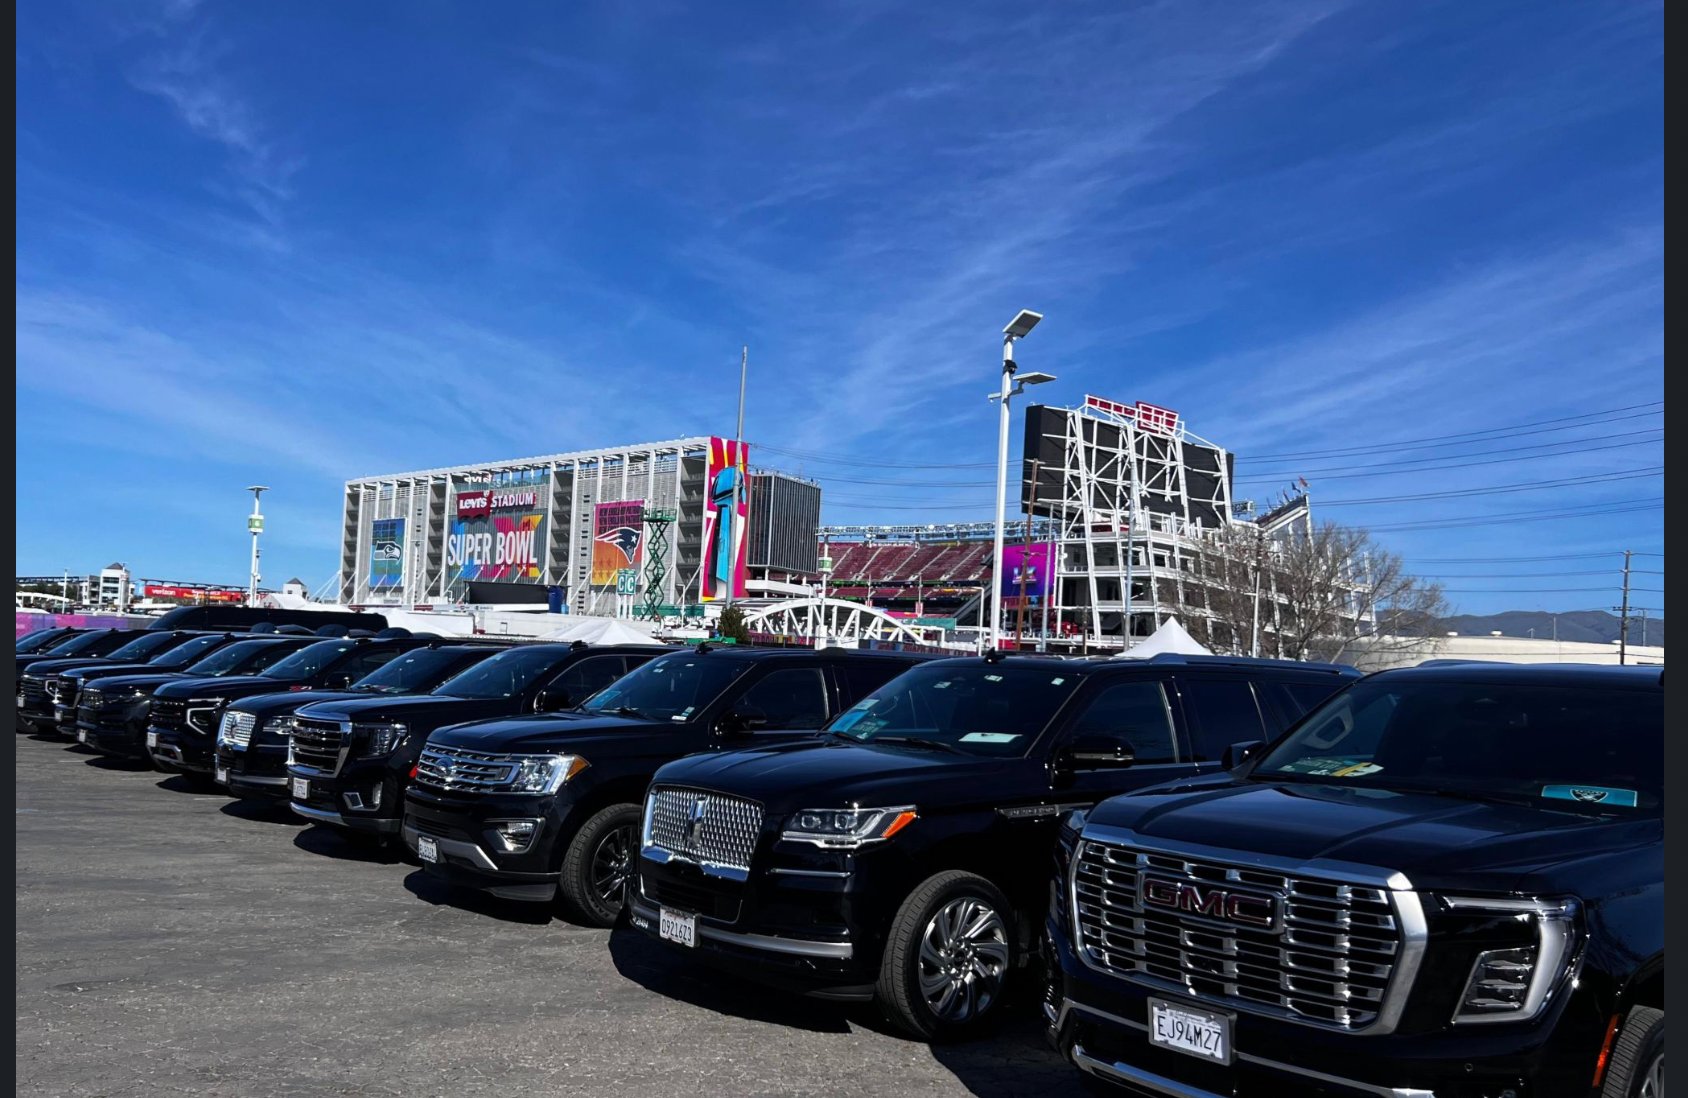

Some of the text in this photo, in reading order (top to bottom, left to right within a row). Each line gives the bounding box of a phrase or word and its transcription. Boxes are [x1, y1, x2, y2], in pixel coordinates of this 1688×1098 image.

[490, 493, 533, 508] STADIUM
[447, 530, 538, 566] SUPER BOWL
[618, 576, 625, 591] C
[627, 576, 634, 591] C
[152, 588, 176, 596] verizon
[1143, 878, 1272, 926] GMC
[1157, 1014, 1221, 1052] EJ94M27
